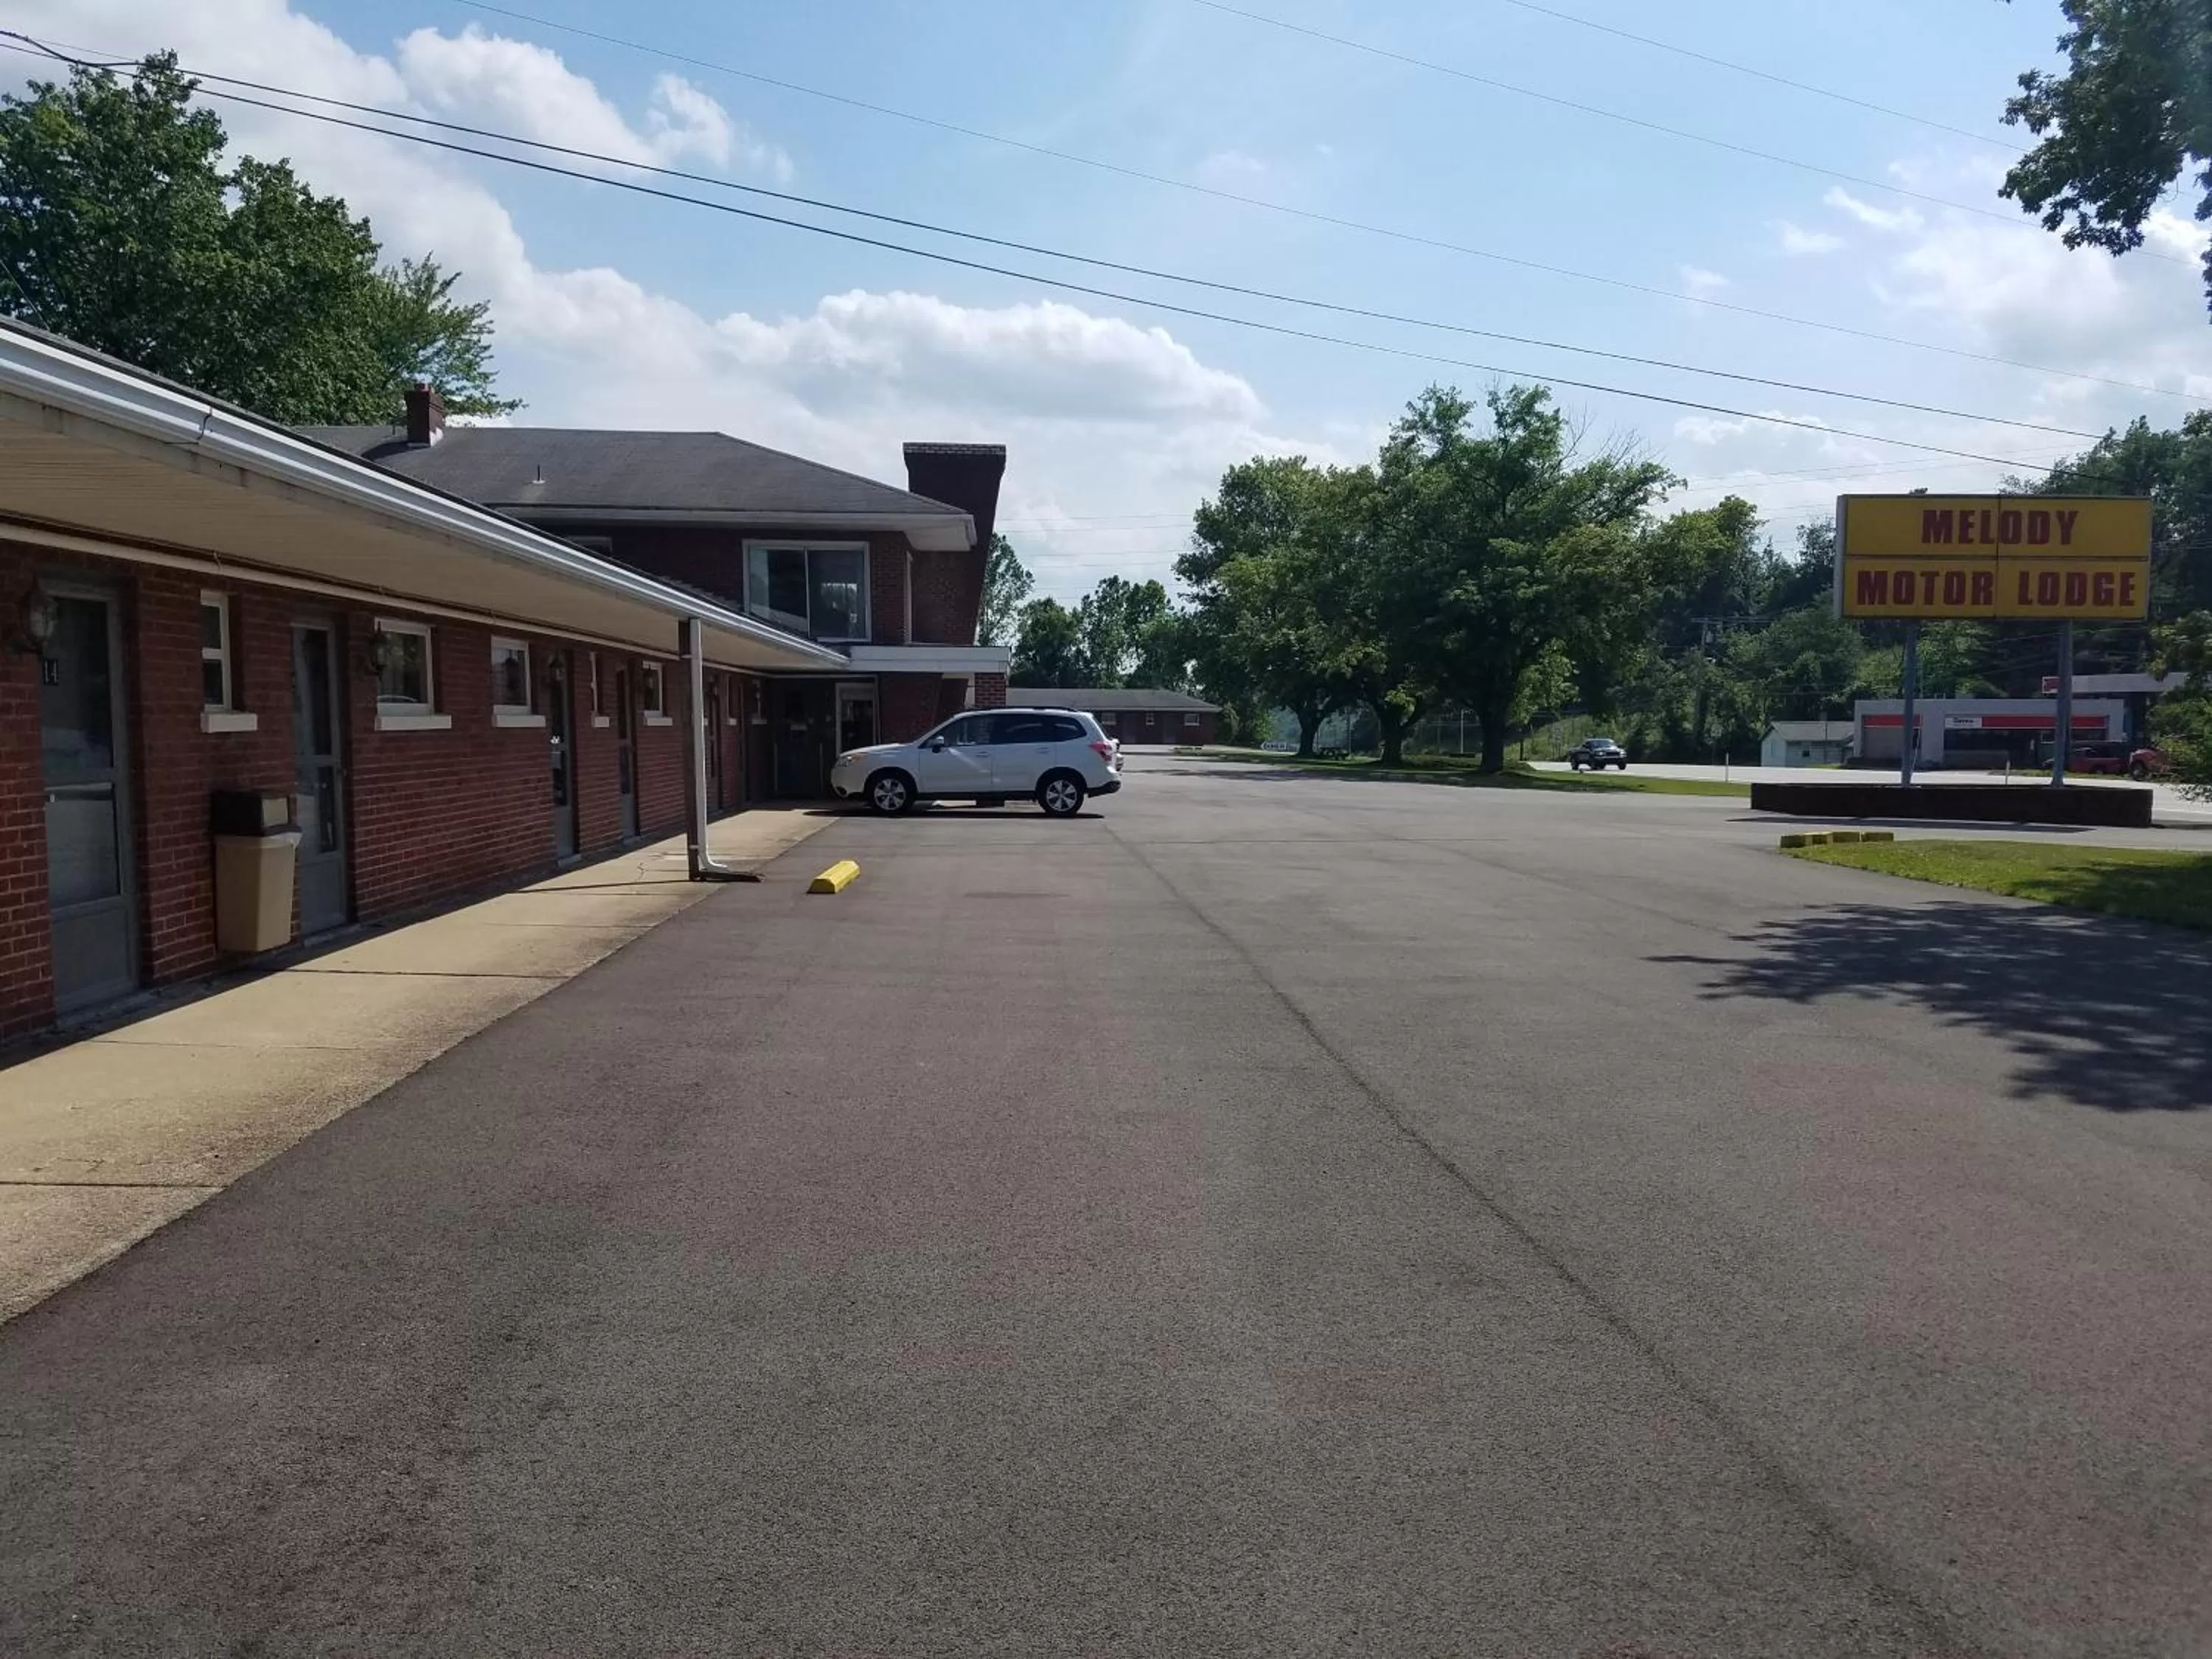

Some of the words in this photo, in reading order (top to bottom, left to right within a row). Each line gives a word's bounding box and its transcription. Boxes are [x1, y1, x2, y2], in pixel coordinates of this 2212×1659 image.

[1921, 509, 2079, 545] MELODY
[1857, 570, 1994, 605] MOTOR
[2017, 571, 2135, 607] LODGE
